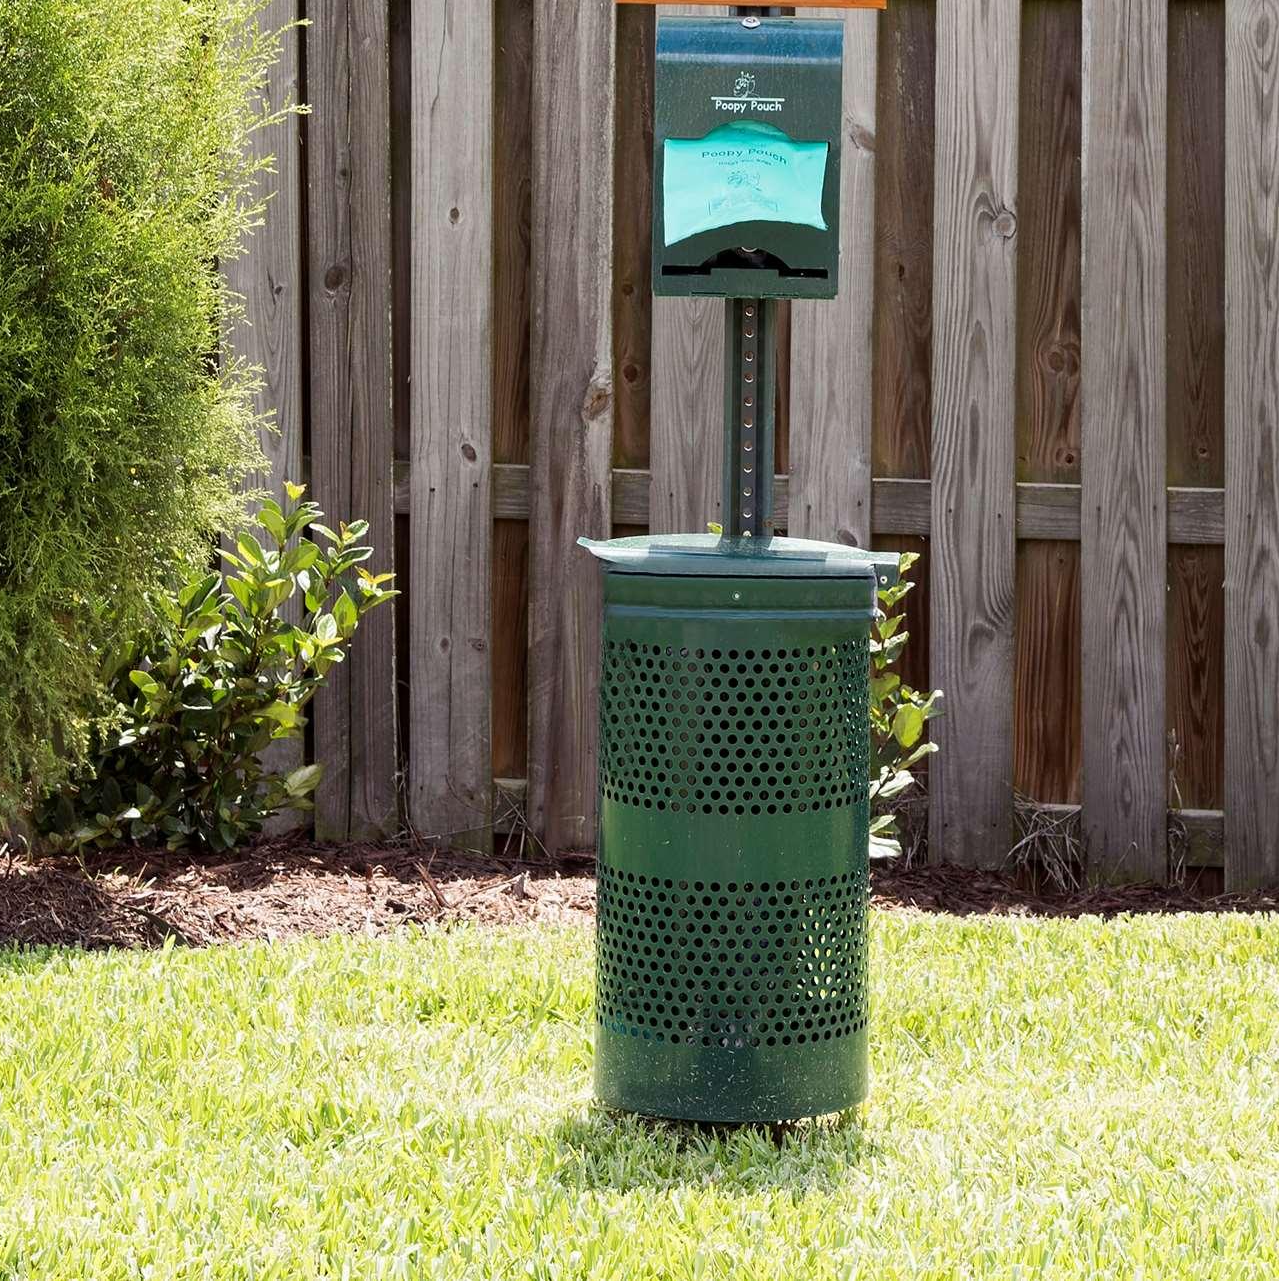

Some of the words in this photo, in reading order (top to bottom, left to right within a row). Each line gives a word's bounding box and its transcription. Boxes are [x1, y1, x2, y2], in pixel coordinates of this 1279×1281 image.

[715, 100, 747, 113] Poopy
[750, 100, 782, 112] Pouch
[702, 150, 743, 158] Poopy
[748, 148, 787, 165] Pouch
